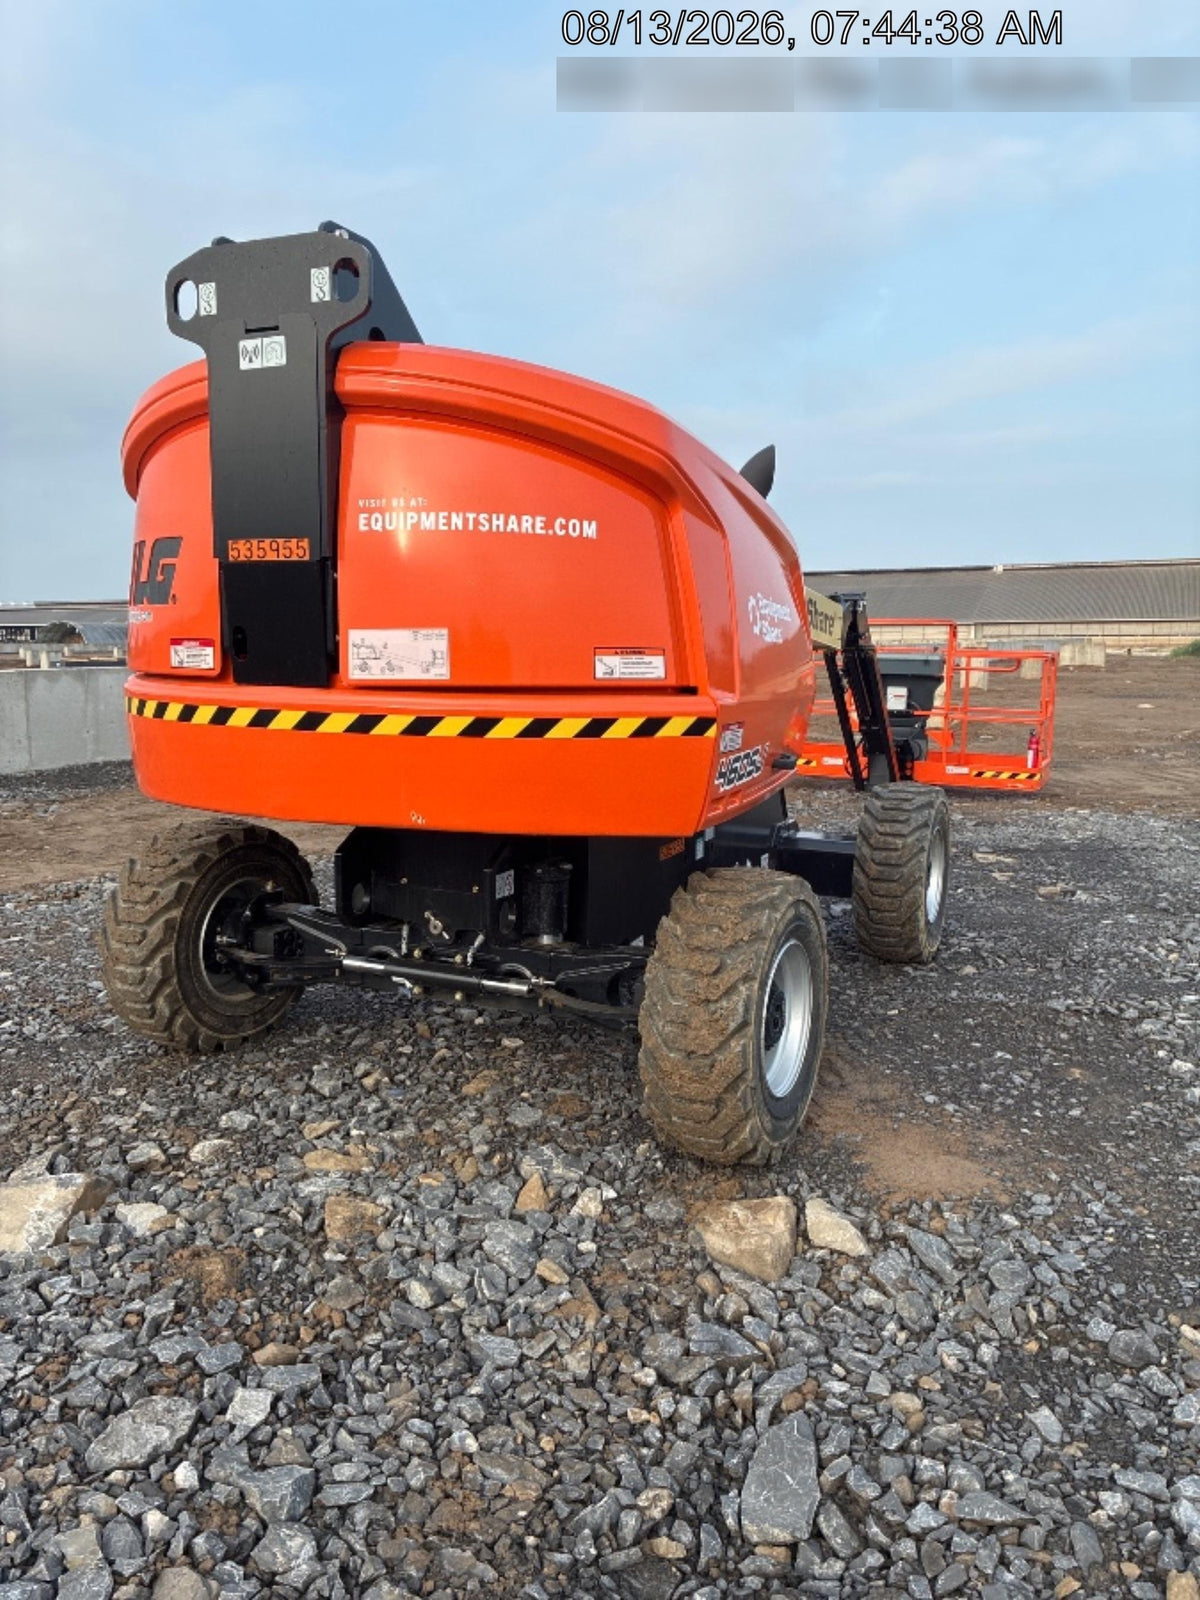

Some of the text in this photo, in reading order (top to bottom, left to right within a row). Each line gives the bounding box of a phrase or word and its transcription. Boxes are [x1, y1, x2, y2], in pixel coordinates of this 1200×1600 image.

[358, 498, 386, 508] VISIT
[358, 511, 597, 540] EQUIPMENTSHARE.COM
[230, 539, 307, 560] 535955
